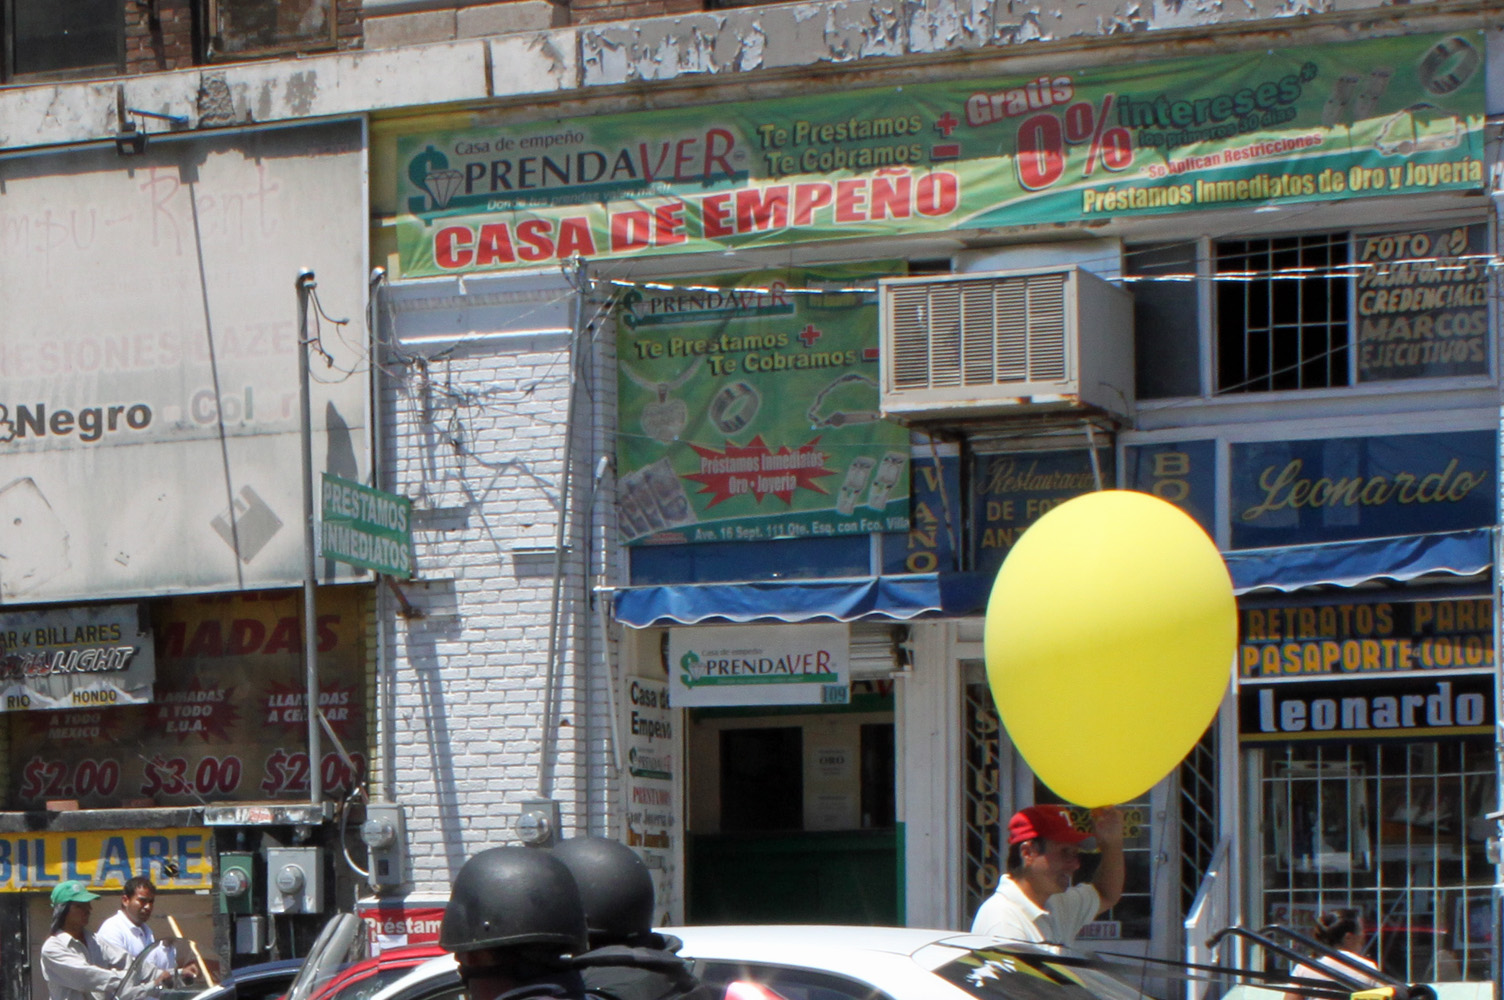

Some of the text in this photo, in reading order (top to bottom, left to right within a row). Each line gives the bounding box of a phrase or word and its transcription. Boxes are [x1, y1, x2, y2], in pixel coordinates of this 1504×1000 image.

[965, 73, 1074, 127] Gratis
[455, 130, 585, 156] Casa de empeño
[758, 115, 922, 148] Te Prestamos
[1014, 92, 1135, 191] 0%
[465, 127, 736, 195] PRENDAVER
[766, 143, 923, 175] Te Cobramos
[1167, 155, 1222, 175] Aplican
[1223, 132, 1323, 164] Restricciones
[1083, 155, 1483, 214] Préstamos Inmediatos de Oro y Joyería
[434, 168, 958, 269] CASA DE EMPEÑO
[1360, 234, 1430, 261] FOTO
[1359, 310, 1487, 341] MARCOS
[635, 332, 790, 359] Te Prestamos
[1358, 337, 1484, 368] EJECUTIVOS
[708, 347, 856, 376] Te Cobramos
[700, 450, 825, 475] Préstamos Inmediatos
[1242, 458, 1488, 521] Leonardo
[323, 480, 407, 533] PRESTAMOS
[986, 499, 1014, 522] DE
[323, 521, 409, 571] INMEDIATOS
[35, 623, 122, 648] BILLARES
[1247, 599, 1493, 641] RETRATOS PARA
[50, 646, 135, 674] LIGHT
[705, 650, 832, 675] PRENDAVER
[1240, 638, 1413, 677] PASAPORTE
[7, 689, 117, 709] RIO HONDO
[630, 680, 657, 707] Casa
[1258, 680, 1486, 733] leonardo
[158, 705, 213, 718] A TODO
[165, 719, 207, 733] E.U.A.
[268, 710, 279, 723] A
[19, 755, 121, 800] $2.00
[140, 754, 243, 799] $3.00
